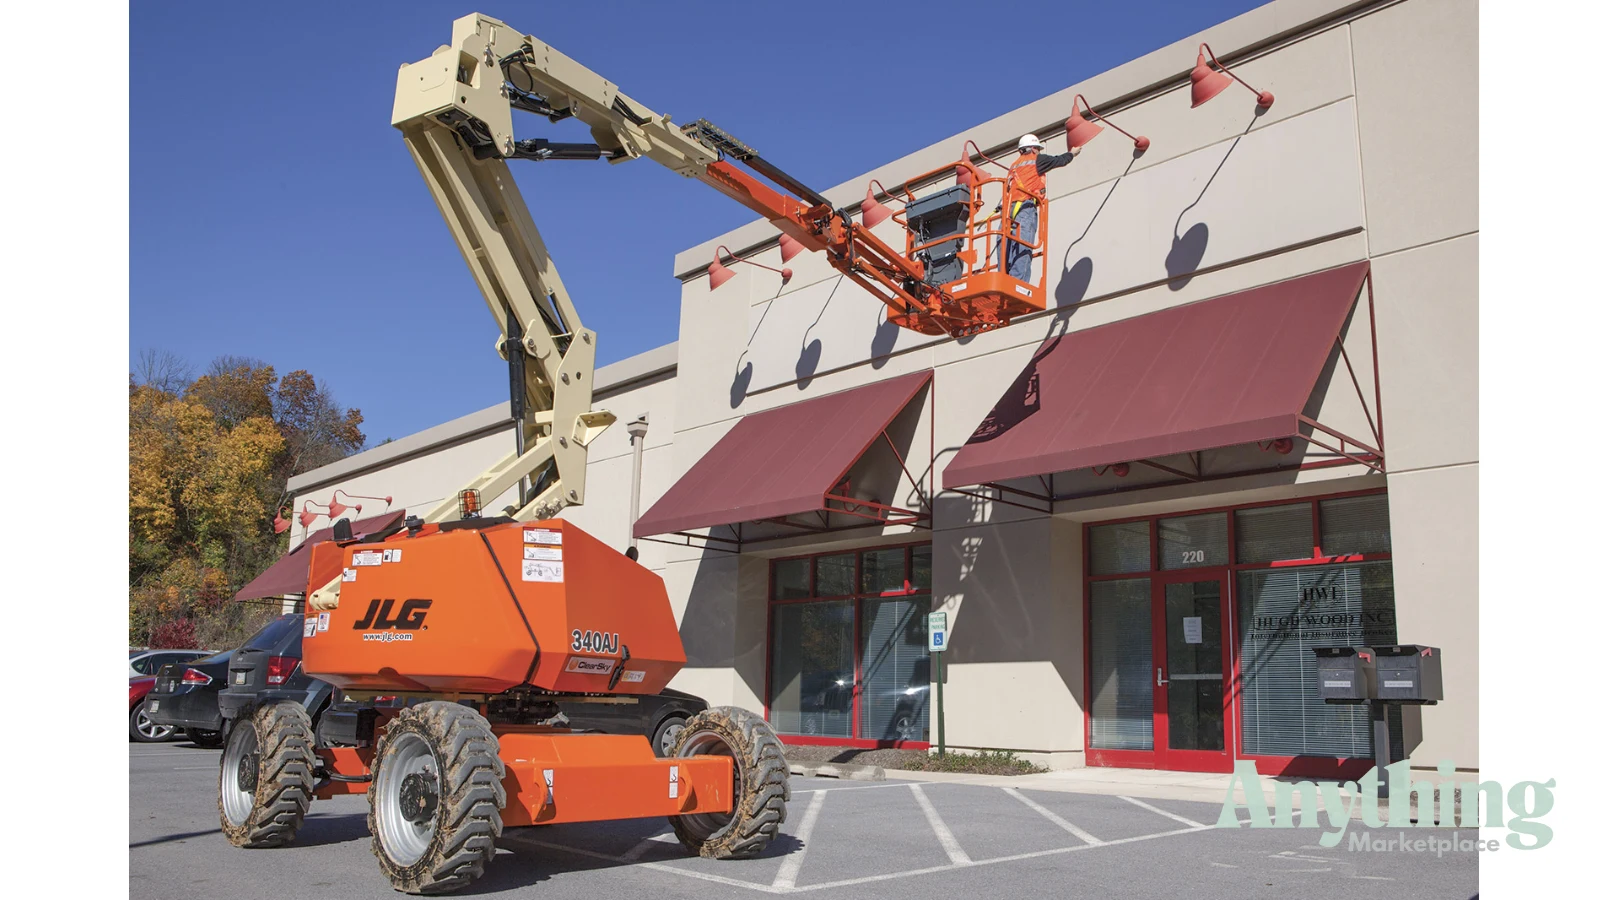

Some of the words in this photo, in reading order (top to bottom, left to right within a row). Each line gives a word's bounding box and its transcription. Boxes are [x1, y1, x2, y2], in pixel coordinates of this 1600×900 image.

[1182, 549, 1205, 564] 220
[1303, 586, 1338, 601] HWI
[353, 599, 433, 630] JLG
[1258, 616, 1300, 628] HUGH
[1304, 614, 1354, 625] WOOD
[363, 632, 413, 643] www.jlg.com
[572, 629, 619, 655] 340AJ
[578, 661, 611, 672] ClearSky
